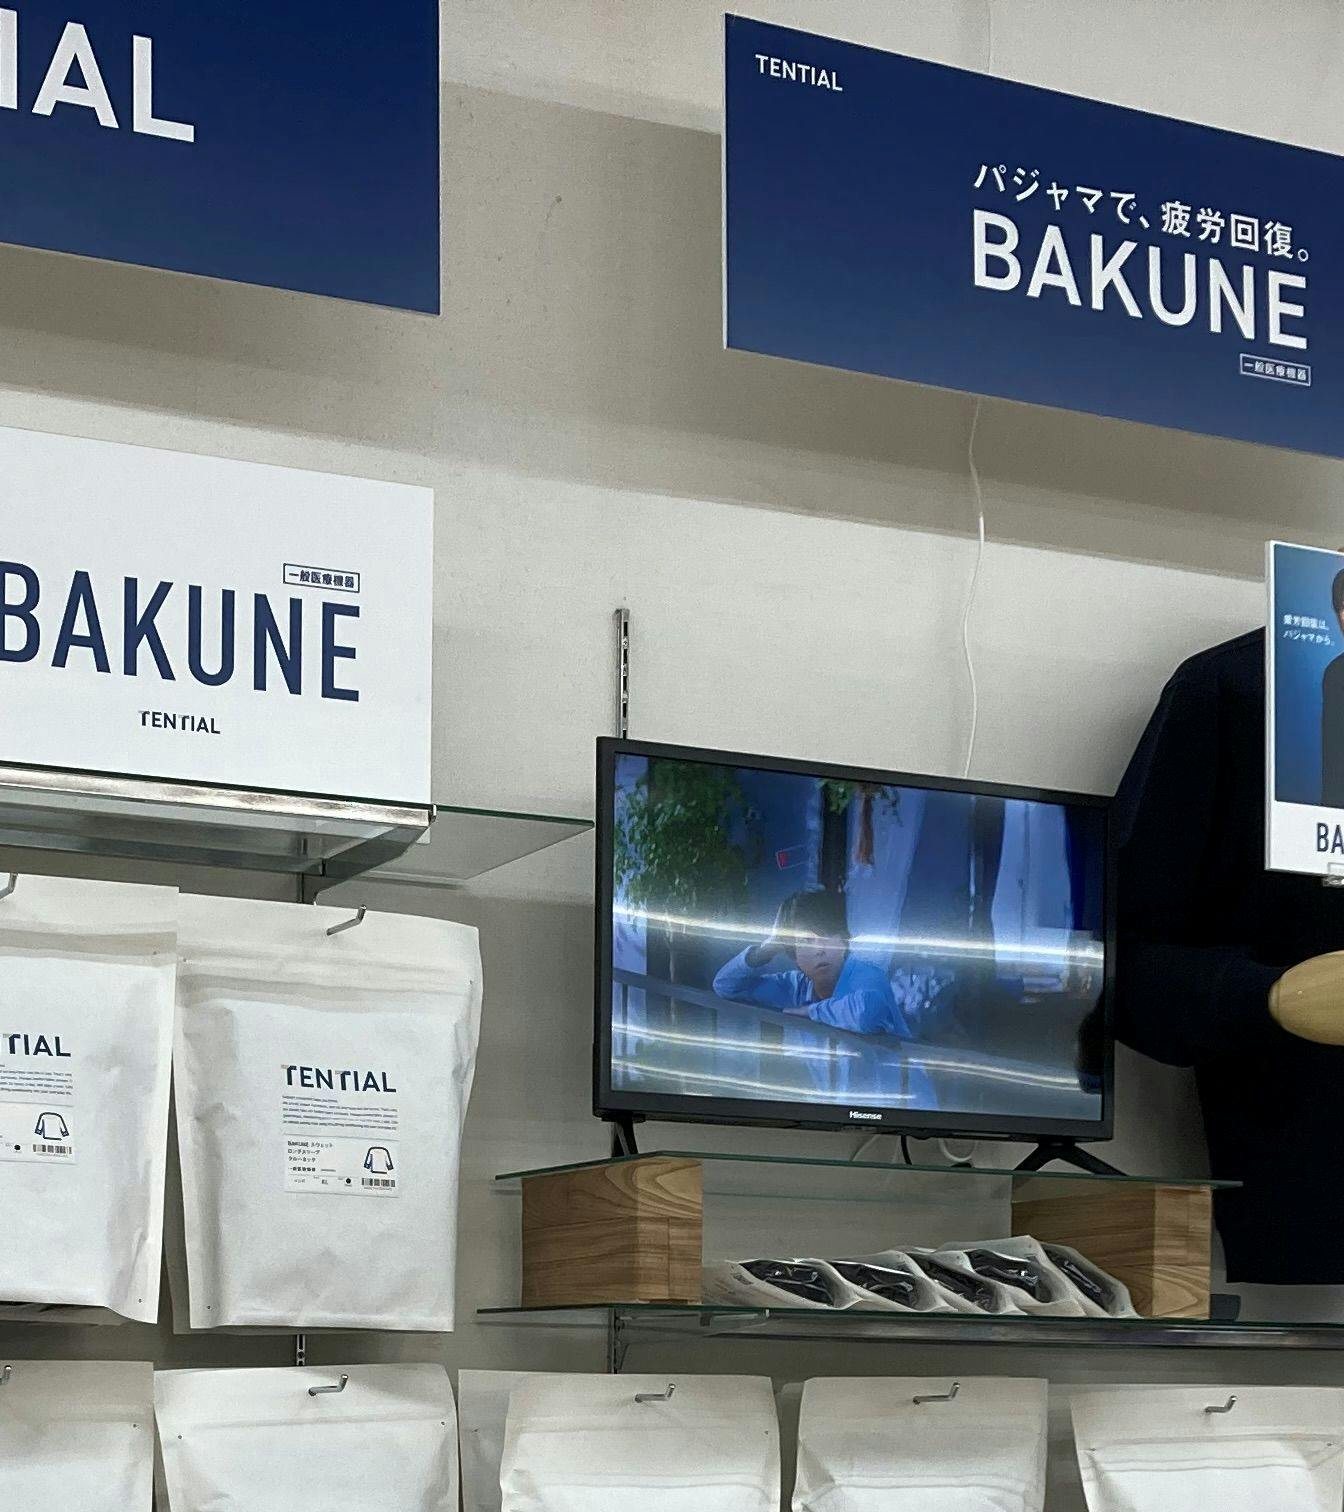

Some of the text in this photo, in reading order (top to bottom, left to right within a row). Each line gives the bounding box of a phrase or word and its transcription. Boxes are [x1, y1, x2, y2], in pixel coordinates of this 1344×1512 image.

[755, 54, 843, 91] TENTIAL
[973, 164, 1309, 262] パジャマで、疲労回復。
[973, 208, 1308, 349] BAKUNE
[138, 710, 221, 734] TENTIAL
[281, 1066, 396, 1092] TENTIAL
